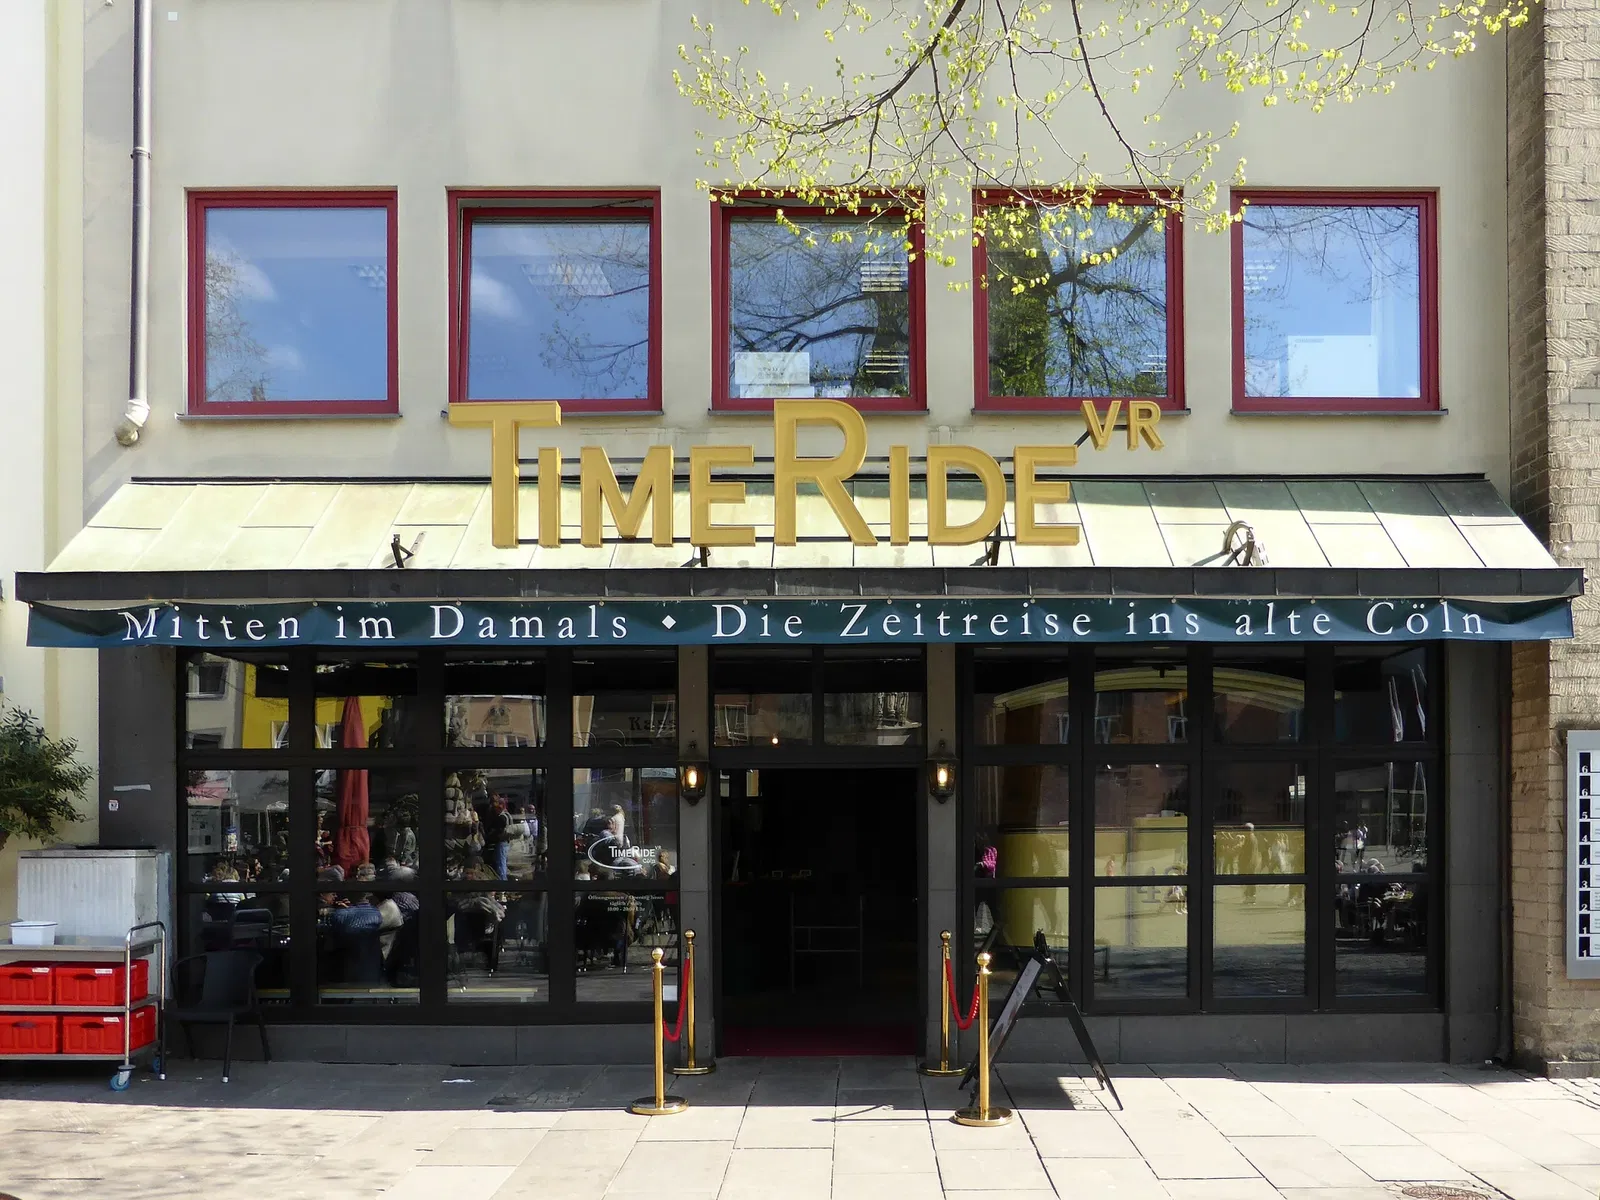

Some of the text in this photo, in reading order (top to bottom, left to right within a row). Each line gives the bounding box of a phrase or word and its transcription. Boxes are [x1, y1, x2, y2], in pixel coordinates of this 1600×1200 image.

[1080, 401, 1164, 451] VR
[118, 601, 1485, 641] Mitten im Damals Die Zeitreise ins alte Cöln
[1581, 765, 1588, 773] 6
[1581, 788, 1588, 796] 6
[1581, 811, 1588, 820] 5
[1581, 834, 1588, 842] 4
[1581, 857, 1588, 865] 4
[1581, 880, 1588, 888] 3
[1581, 903, 1588, 911] 2
